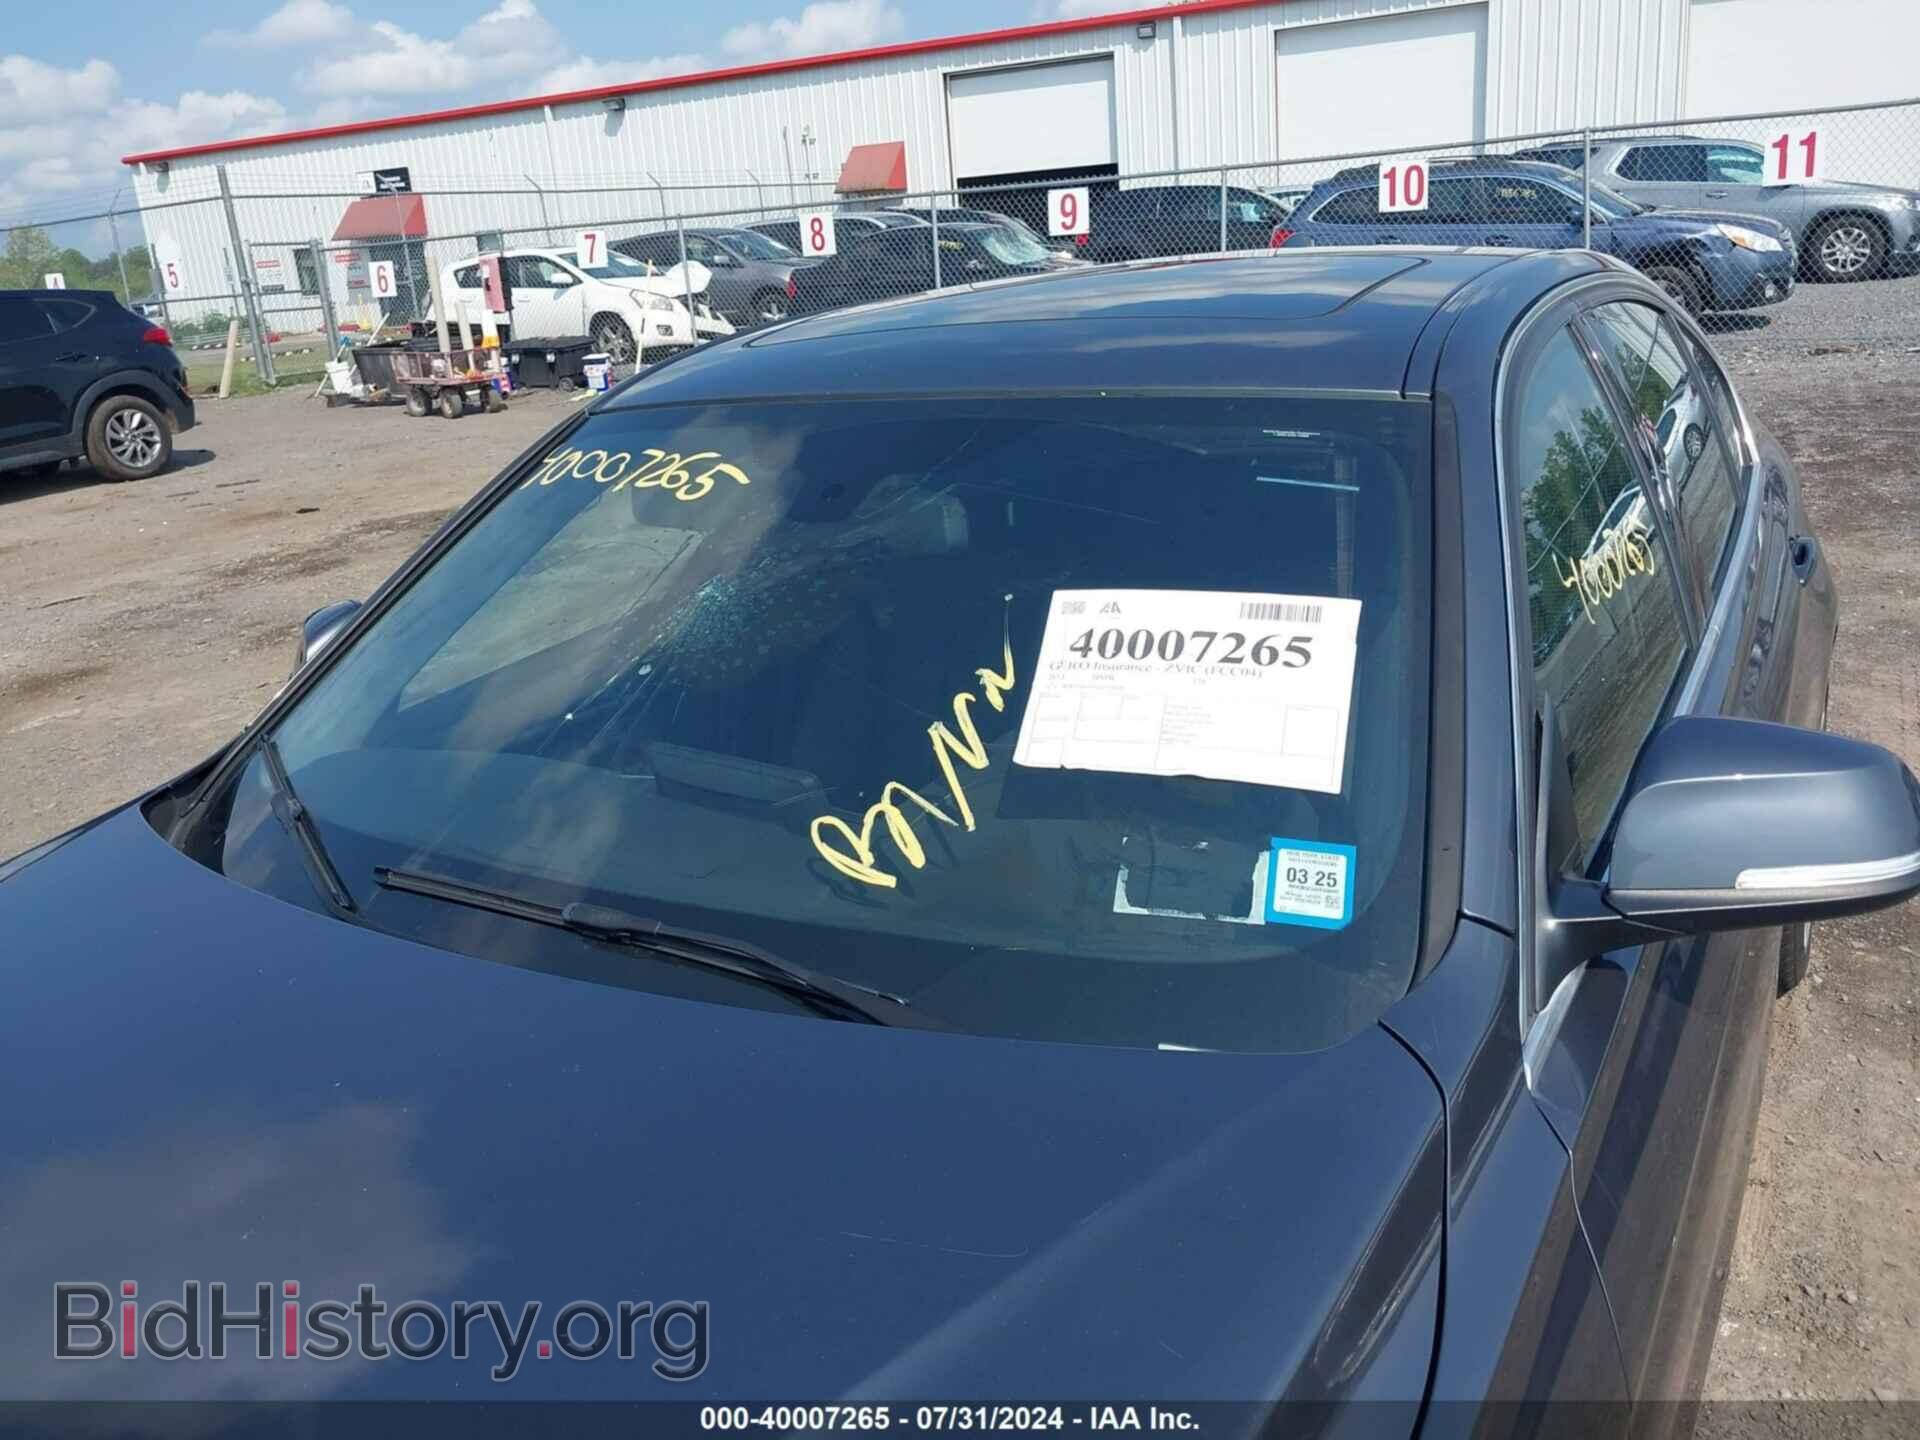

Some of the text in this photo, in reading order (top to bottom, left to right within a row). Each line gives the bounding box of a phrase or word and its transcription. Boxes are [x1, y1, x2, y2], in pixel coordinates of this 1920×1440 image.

[1770, 130, 1818, 180] 11
[1382, 163, 1425, 208] 10
[1058, 192, 1078, 230] 9
[584, 233, 596, 264] 7
[808, 216, 826, 252] 8
[166, 262, 179, 288] 5
[376, 264, 389, 293] 6
[1069, 628, 1313, 668] 40007265
[1286, 867, 1337, 888] 03 25
